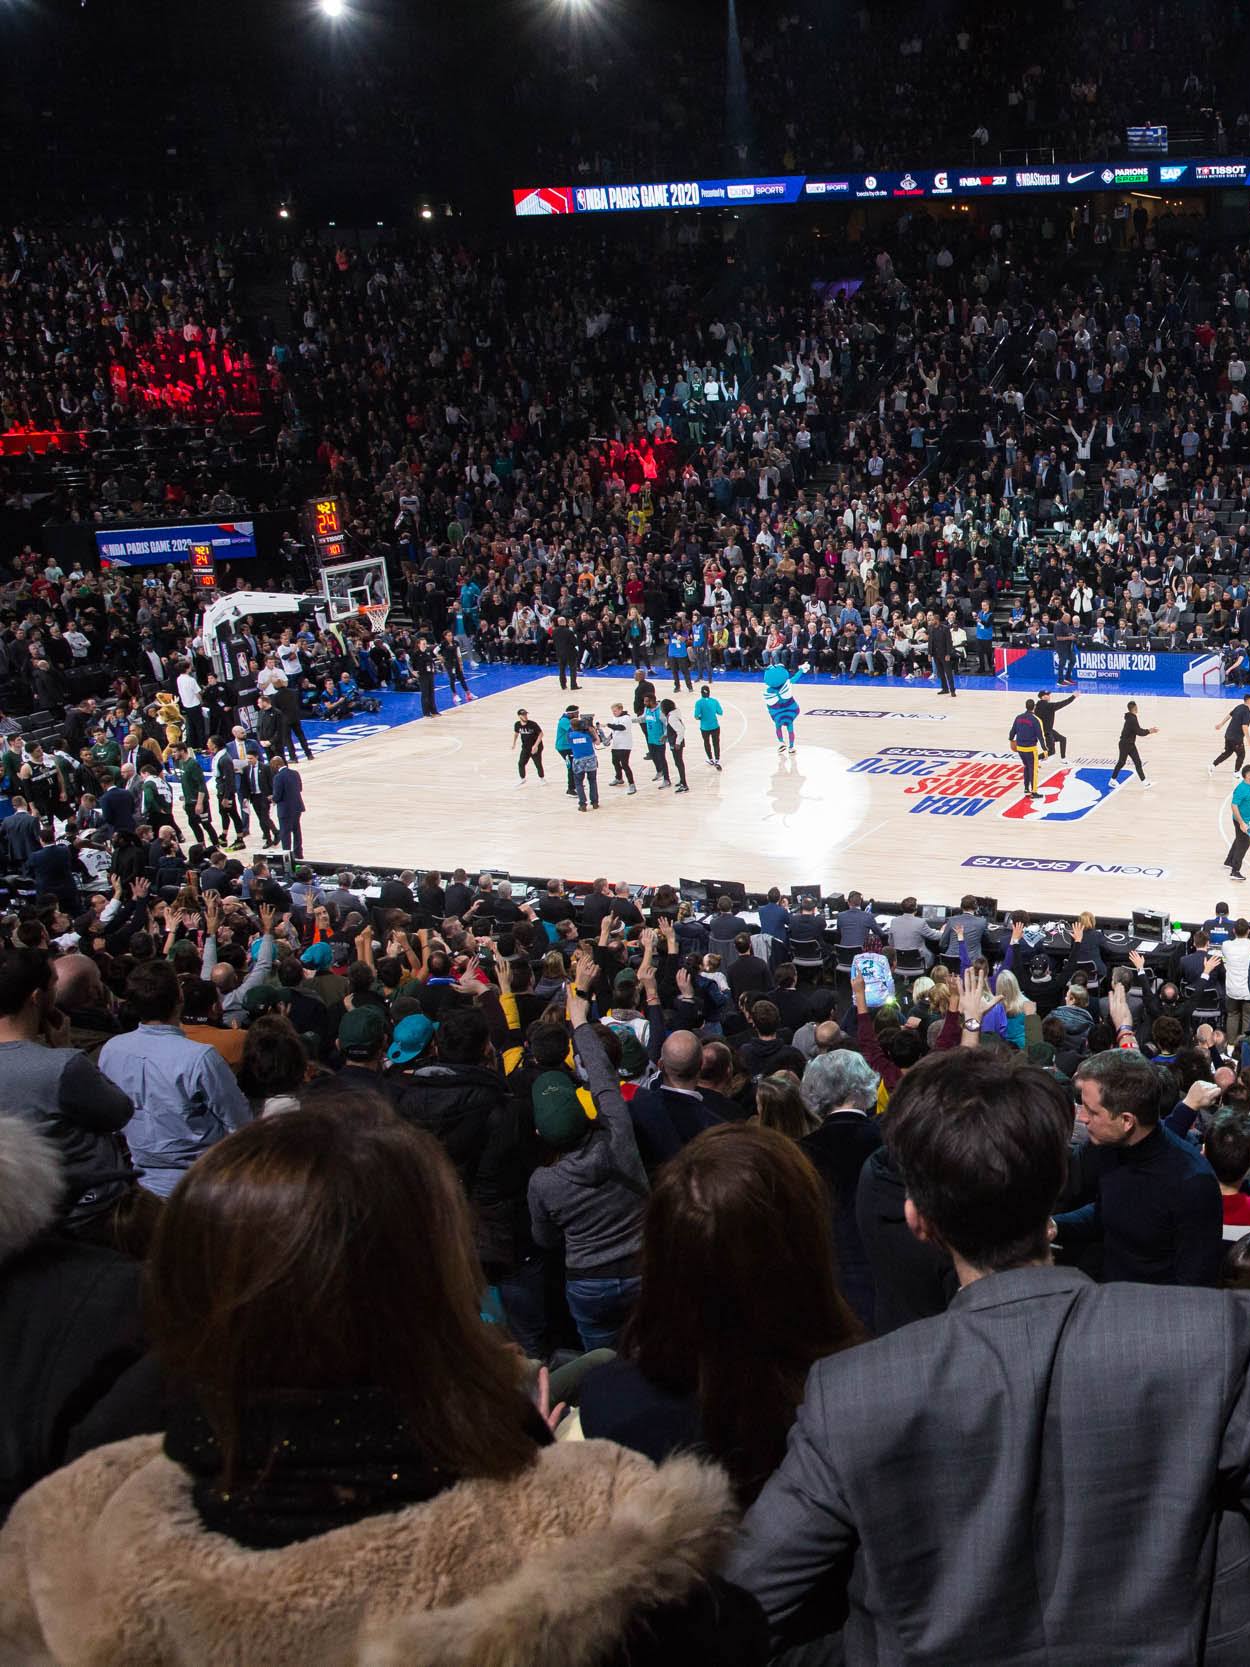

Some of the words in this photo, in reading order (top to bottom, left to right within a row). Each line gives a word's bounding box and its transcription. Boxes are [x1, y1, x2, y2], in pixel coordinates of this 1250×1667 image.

[1114, 168, 1148, 176] PARIONS
[1161, 167, 1182, 180] SAP
[1208, 165, 1246, 175] TISSOT
[586, 188, 609, 210] NBA
[609, 187, 640, 209] PARIS
[640, 185, 669, 208] GAME
[670, 183, 700, 206] 2020
[755, 185, 784, 194] SPORTS
[317, 514, 337, 534] 24
[110, 544, 127, 556] NBA
[127, 542, 150, 555] PARIS
[150, 540, 172, 554] GAME
[195, 554, 208, 566] 24
[1080, 652, 1107, 670] PARIS
[1107, 653, 1132, 670] GAME
[1132, 653, 1156, 671] 2020
[886, 748, 970, 757] SPORTS
[846, 758, 950, 776] 2020
[904, 777, 1022, 798] PARIS
[908, 795, 997, 816] NBA
[972, 857, 1072, 870] SPORTS
[1085, 863, 1165, 878] beIN
